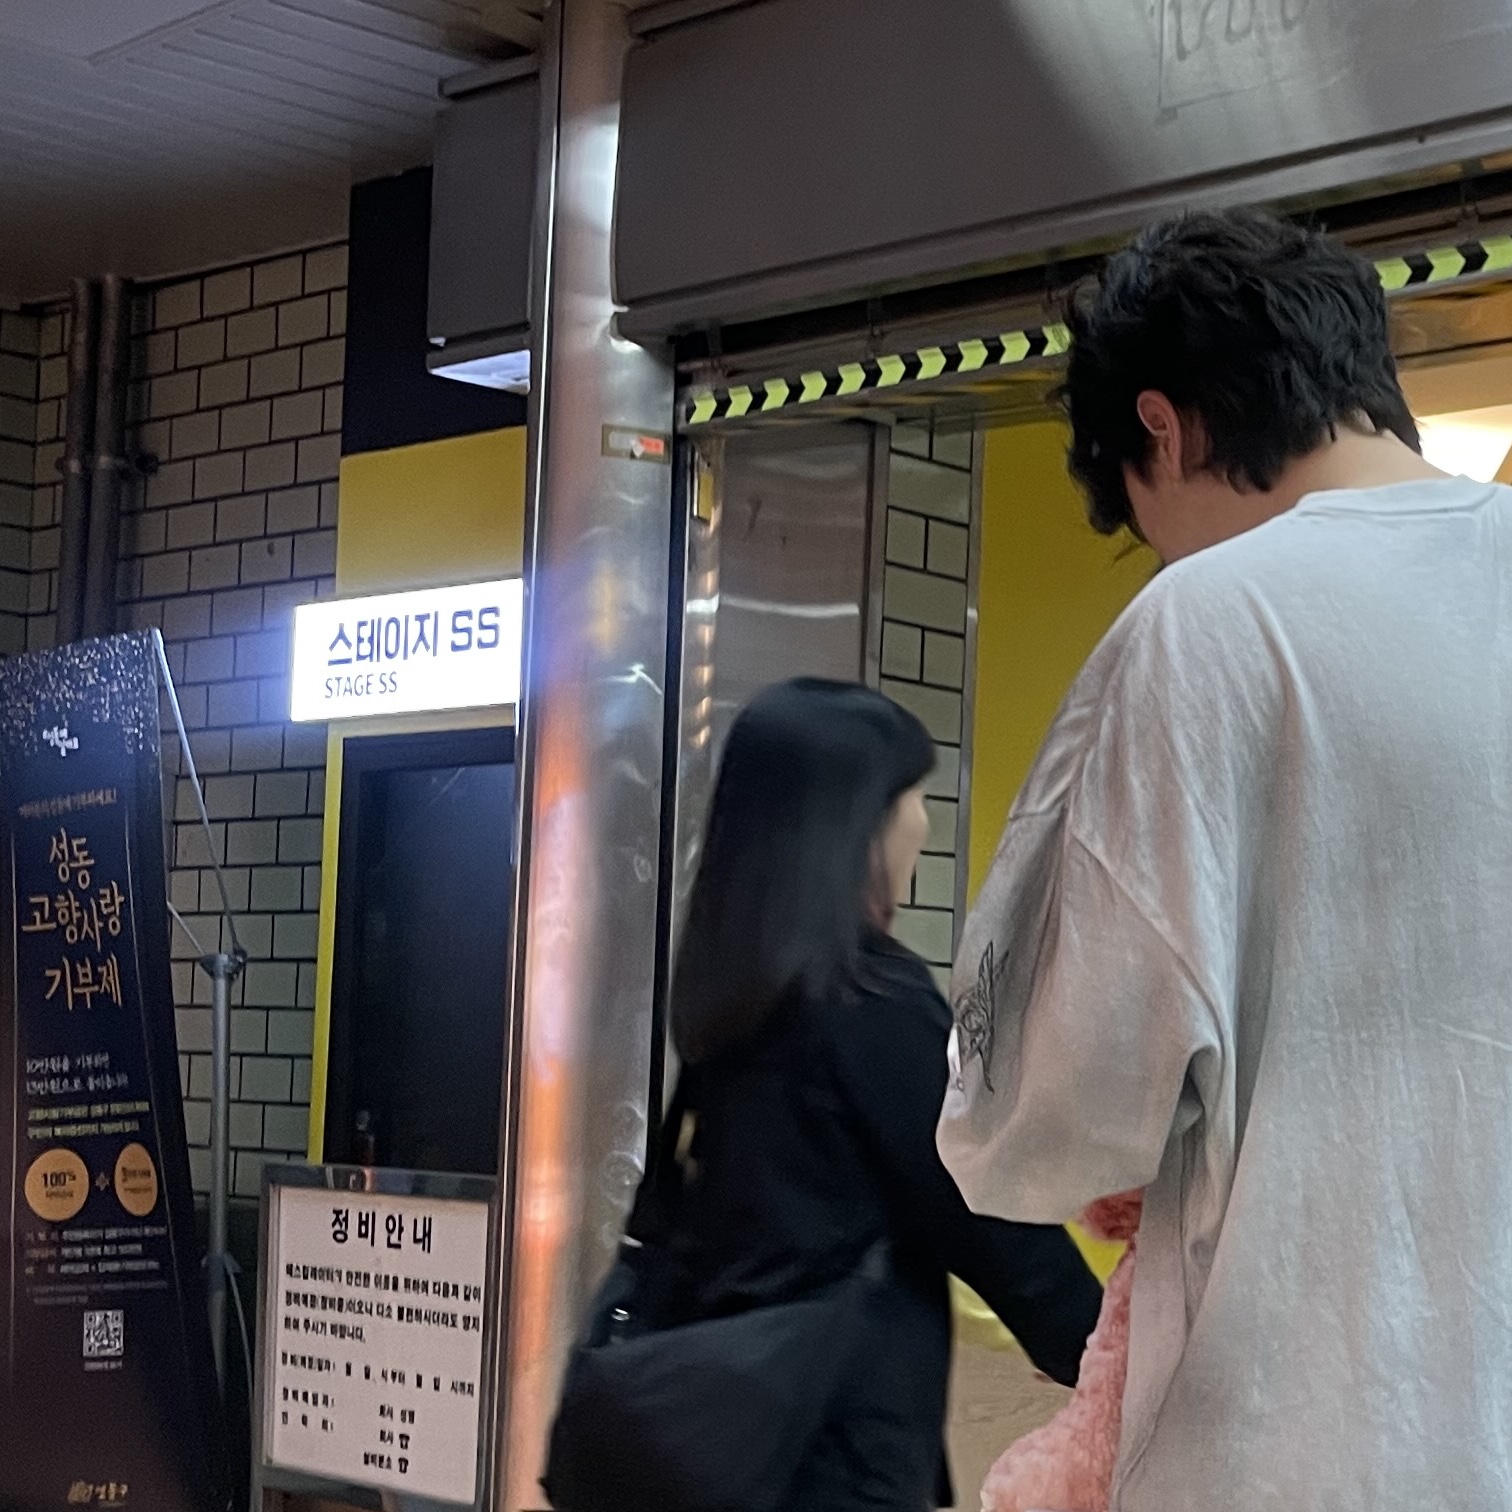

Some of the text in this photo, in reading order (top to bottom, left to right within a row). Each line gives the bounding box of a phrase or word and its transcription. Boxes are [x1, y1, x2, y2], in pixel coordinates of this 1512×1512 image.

[328, 606, 500, 666] 스테이지 SS
[324, 671, 398, 699] STAGE SS
[49, 828, 95, 890] 성동
[22, 880, 125, 952] 고향사랑
[45, 953, 123, 1011] 기부제
[332, 1208, 432, 1253] 정비안내
